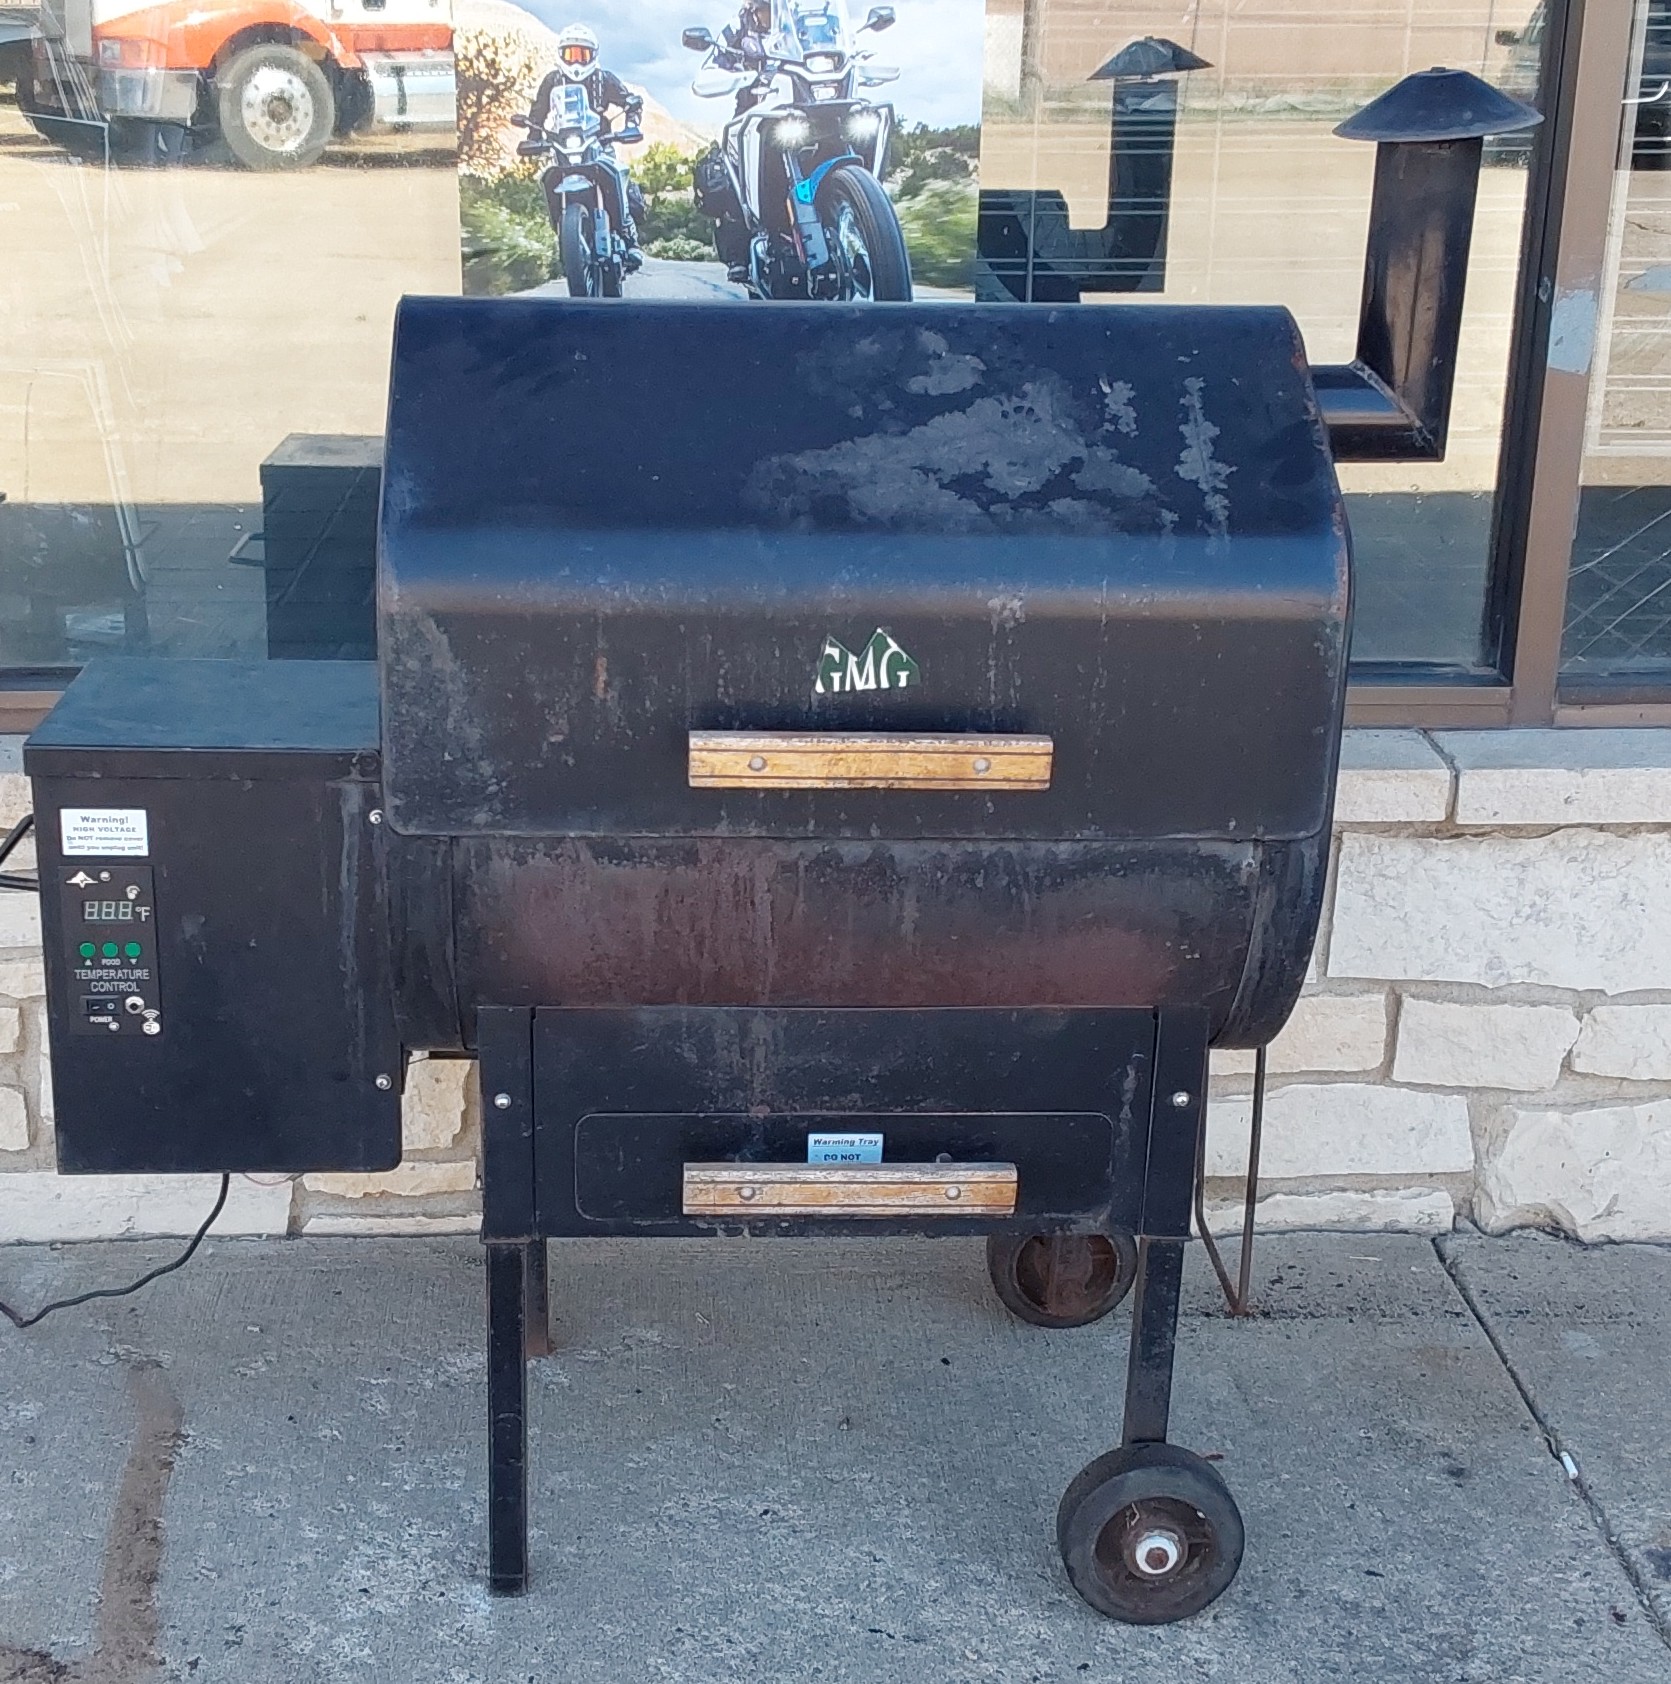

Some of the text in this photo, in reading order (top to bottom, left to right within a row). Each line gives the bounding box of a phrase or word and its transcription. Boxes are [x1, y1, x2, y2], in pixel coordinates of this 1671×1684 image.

[815, 640, 910, 693] GMG
[80, 815, 128, 825] Warning!
[101, 958, 121, 966] FOOD
[74, 969, 150, 980] TEMPERATURE
[90, 981, 140, 992] CONTROL
[813, 1138, 879, 1147] Warming Tray
[823, 1153, 861, 1161] DO NOT
